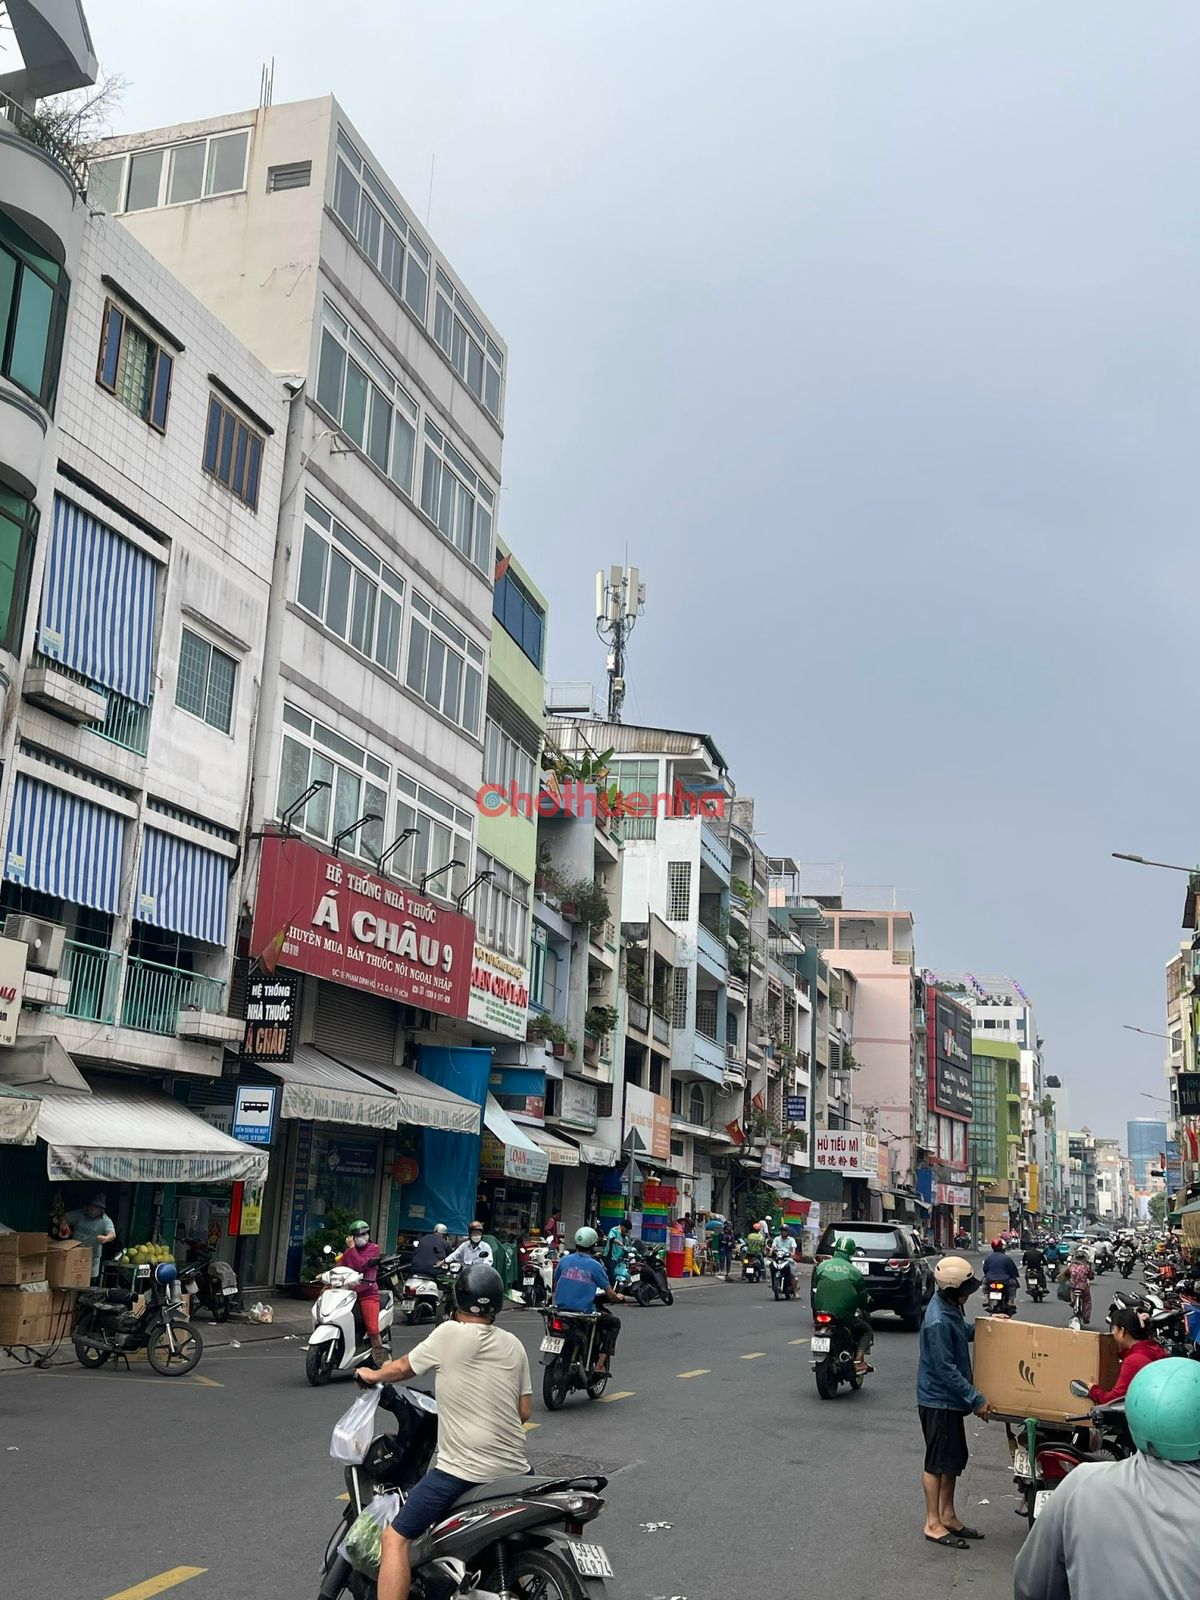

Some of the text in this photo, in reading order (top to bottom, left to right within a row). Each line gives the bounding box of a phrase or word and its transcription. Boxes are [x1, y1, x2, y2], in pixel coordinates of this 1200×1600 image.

[325, 863, 437, 924] HỆ THỐNG NHÀ THUỐC
[311, 889, 453, 973] Á CHÂU 9
[286, 925, 453, 992] HUYÊN MUA BÁN THUỐC NỘI NGOẠI NHẬP
[251, 982, 291, 999] HỆ THỐNG
[247, 999, 291, 1021] NHÀ THUỐC
[244, 1022, 287, 1055] Á CHÂU
[250, 1134, 266, 1142] STOP
[817, 1134, 829, 1151] HỦ
[830, 1135, 846, 1152] TIẾU
[849, 1137, 859, 1152] MÌ
[824, 1263, 849, 1274] Grab
[575, 1543, 602, 1560] 59-L1
